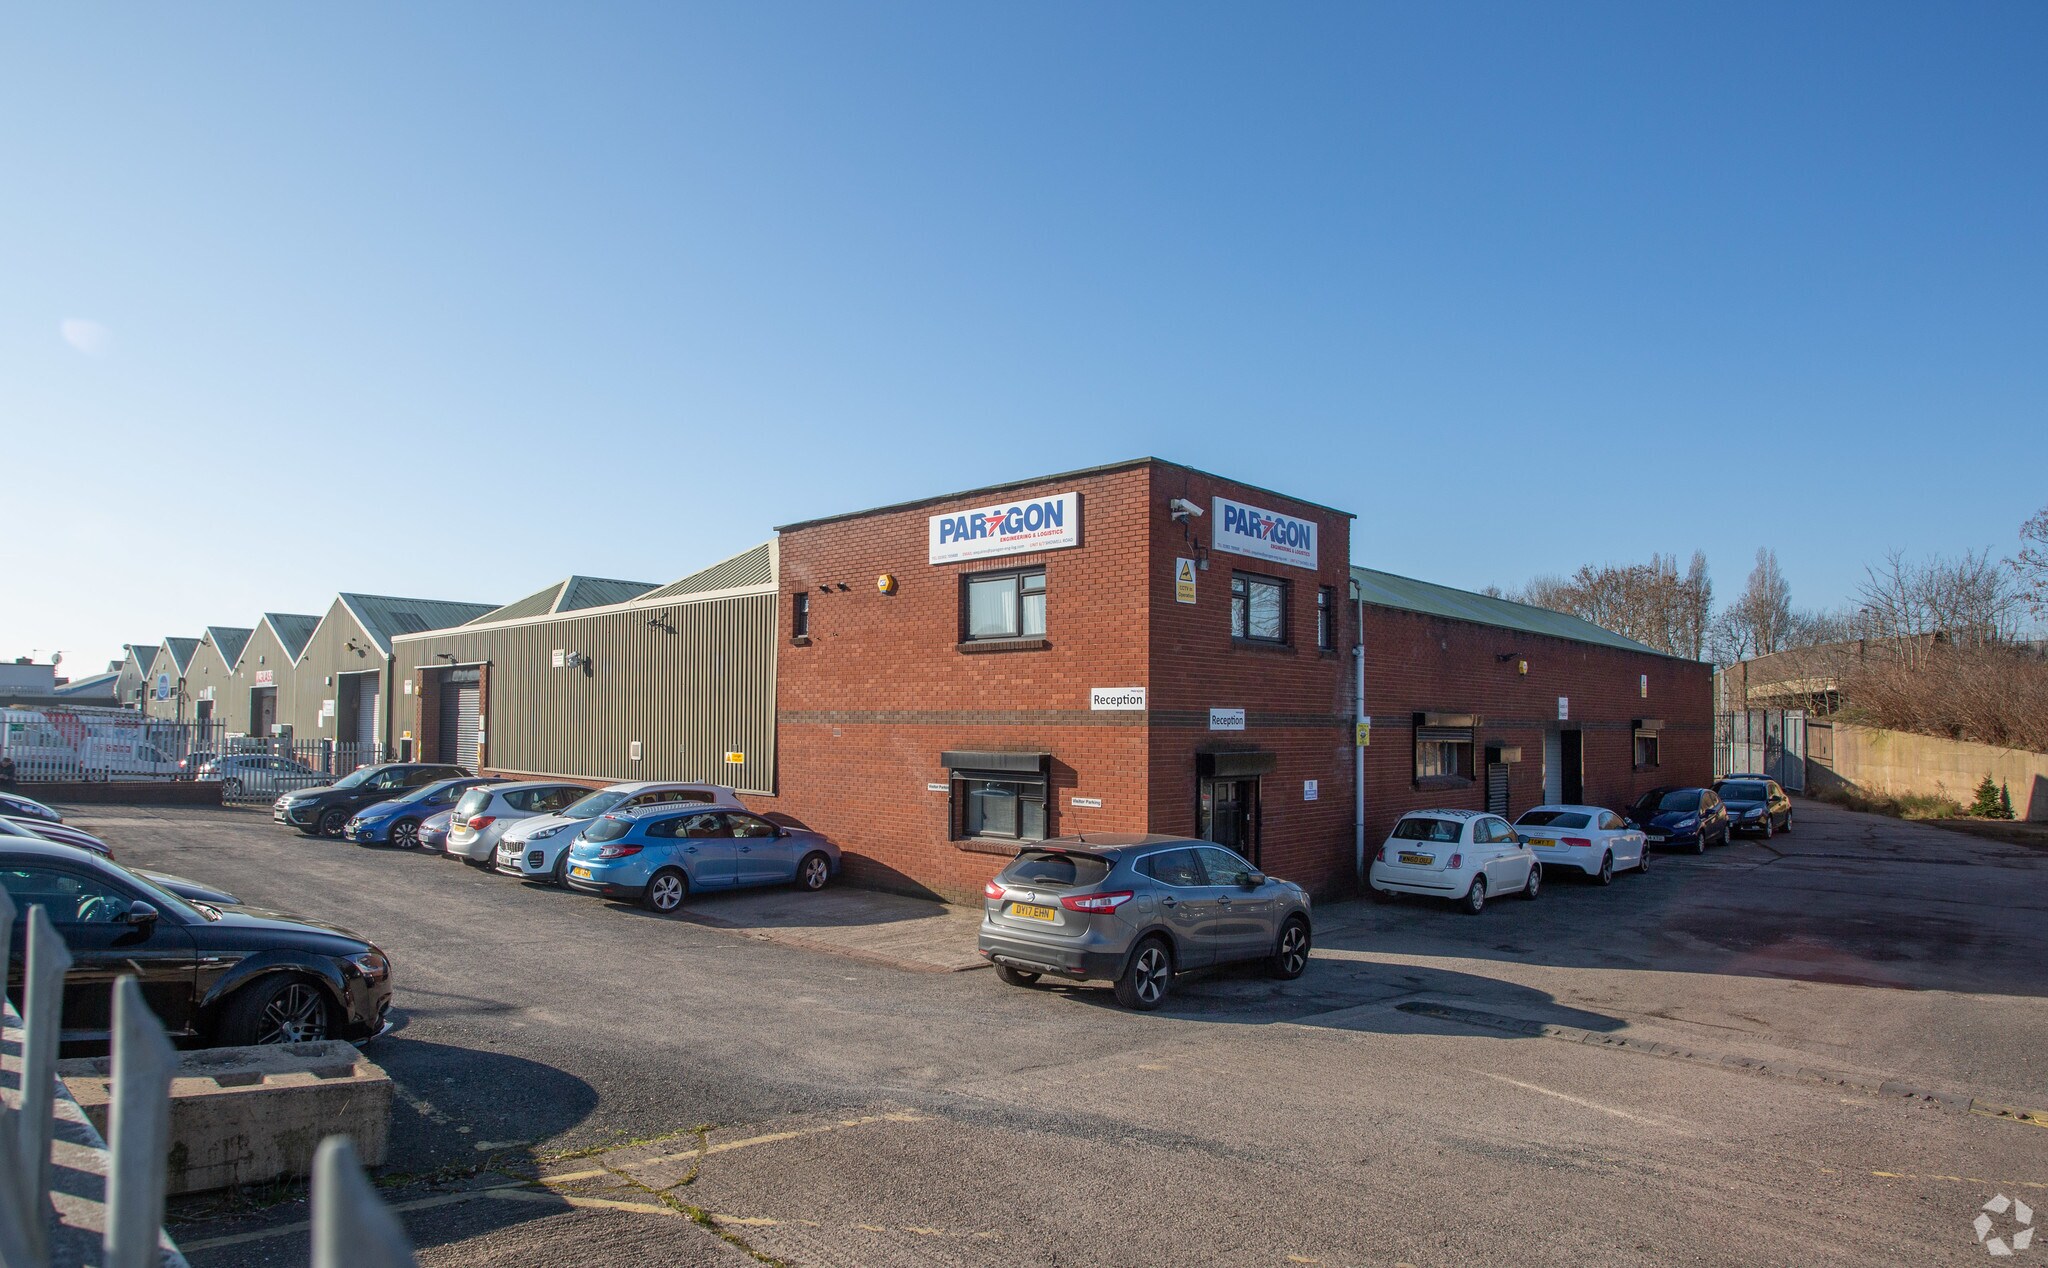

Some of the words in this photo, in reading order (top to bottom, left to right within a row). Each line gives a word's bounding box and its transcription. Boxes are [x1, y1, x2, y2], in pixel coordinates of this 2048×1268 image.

[940, 500, 1063, 544] PARAGON
[1224, 504, 1311, 550] PARAGON
[1000, 533, 1032, 543] ENGINEERING
[1037, 528, 1064, 538] LOGISTICS
[1094, 693, 1143, 707] Reception
[1211, 715, 1244, 727] Reception
[1016, 905, 1033, 916] DY17
[1033, 907, 1050, 918] EHN
